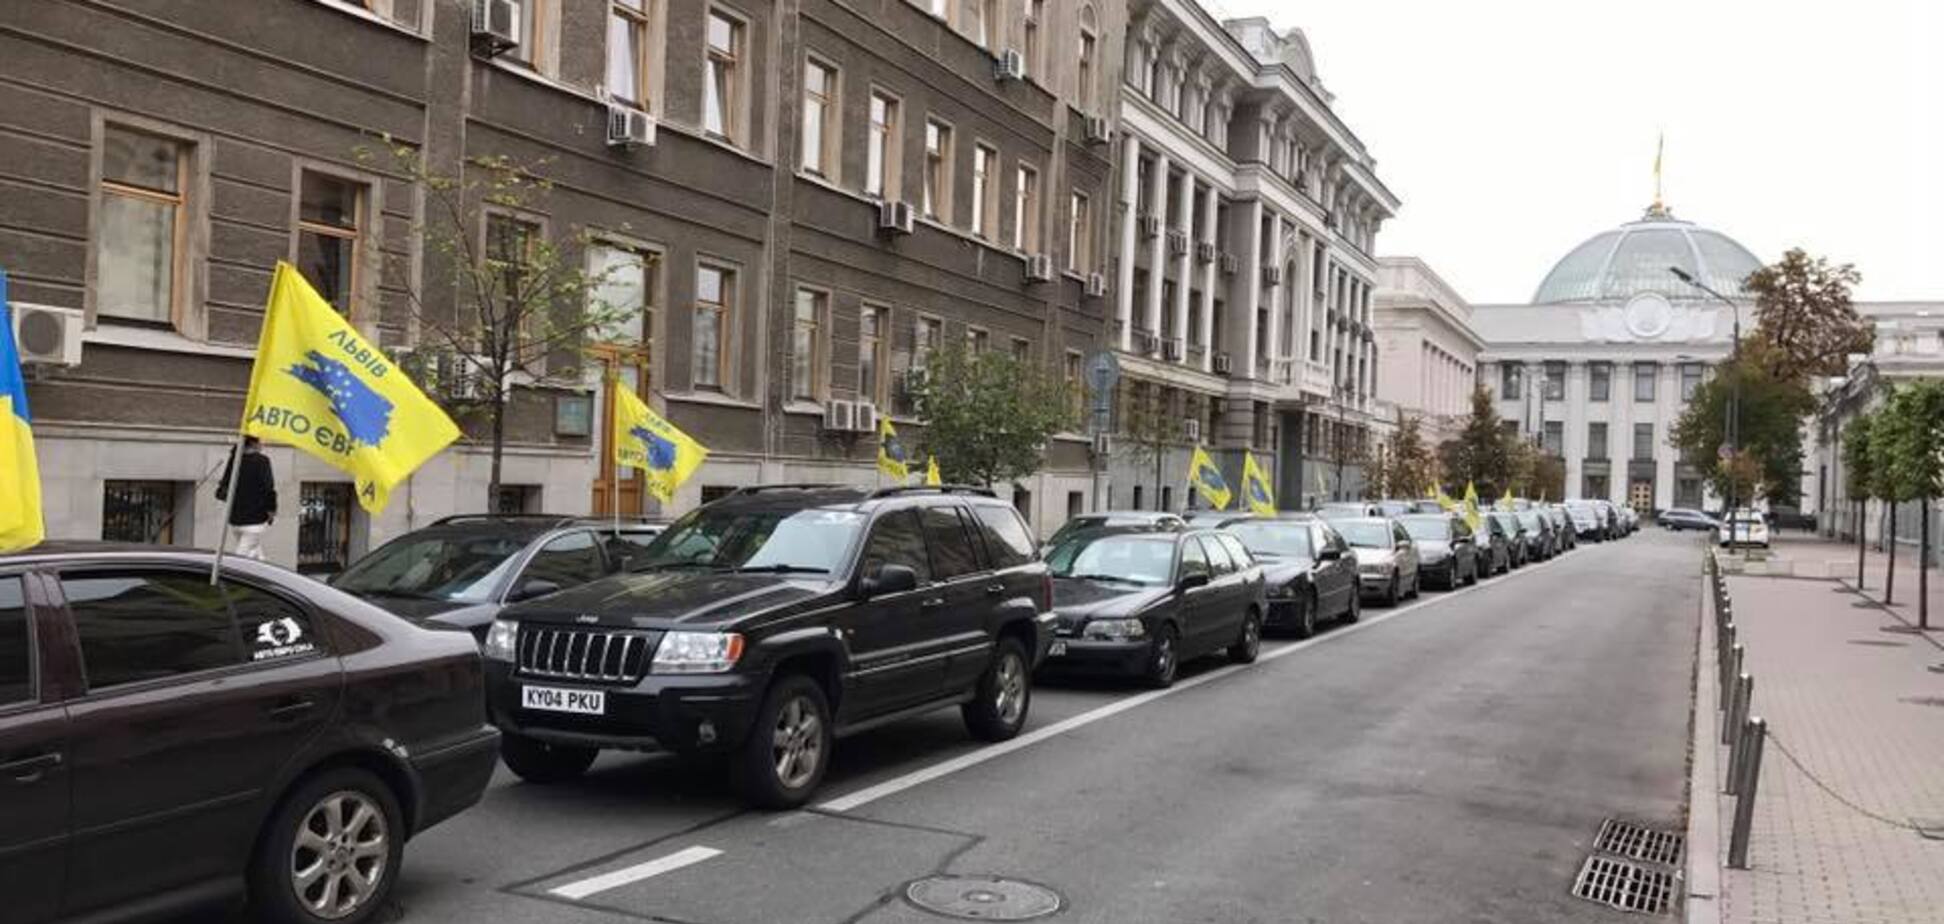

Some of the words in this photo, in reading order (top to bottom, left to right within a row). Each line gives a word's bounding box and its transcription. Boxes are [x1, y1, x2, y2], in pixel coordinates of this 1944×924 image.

[328, 329, 388, 378] ЛЬВІВ
[251, 405, 311, 434] АВТО
[528, 689, 562, 706] KY04
[568, 691, 600, 711] PKU
